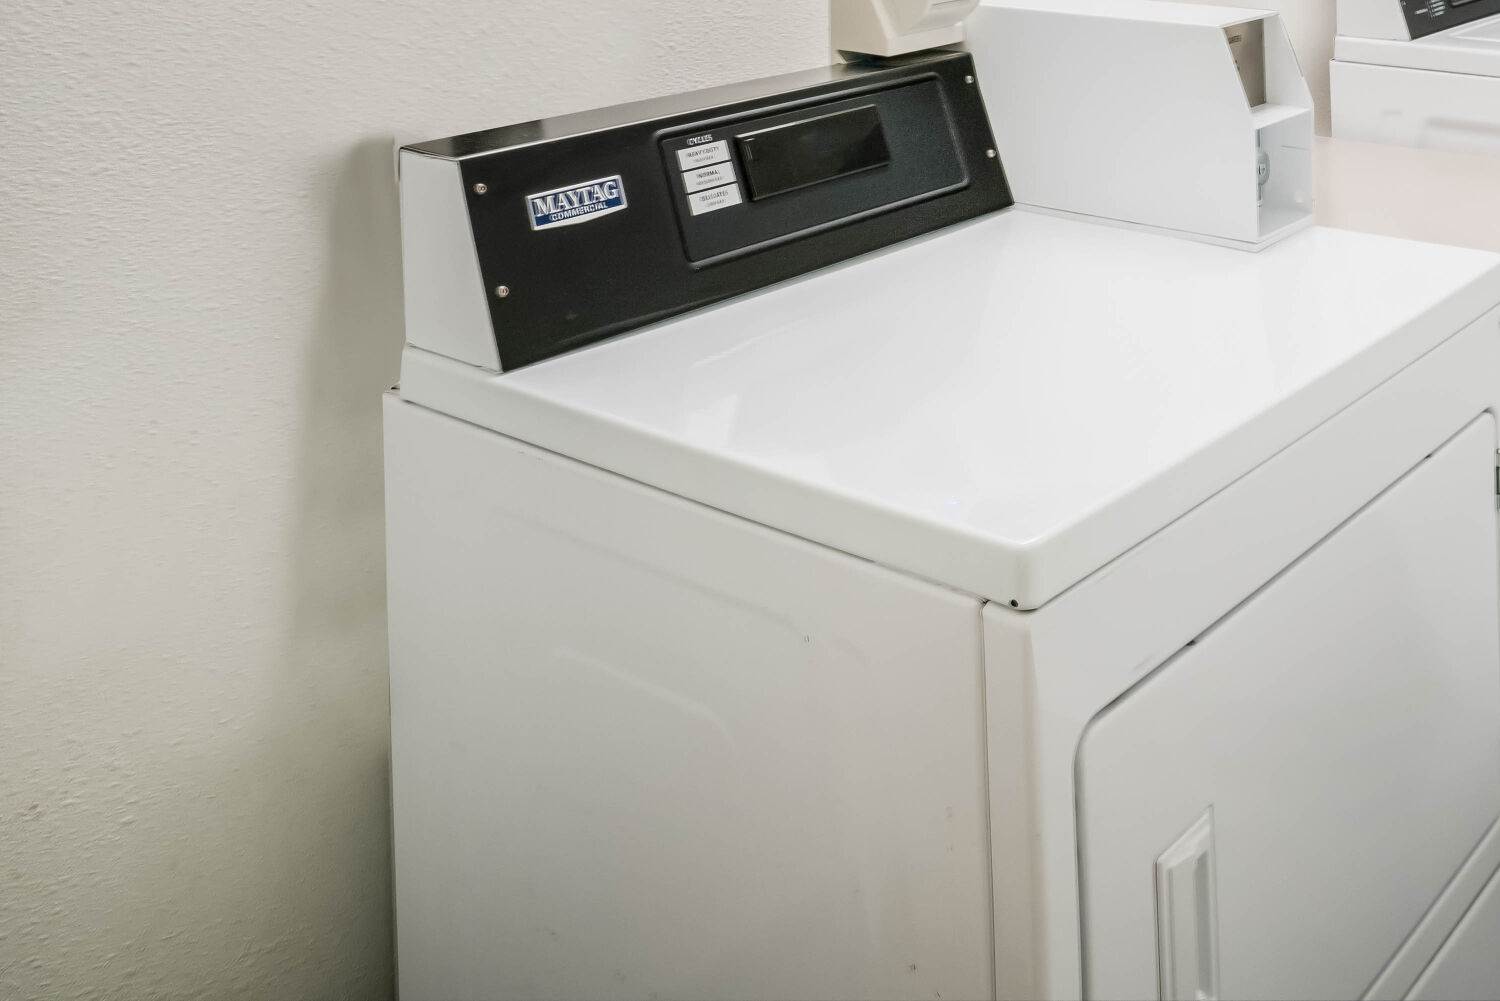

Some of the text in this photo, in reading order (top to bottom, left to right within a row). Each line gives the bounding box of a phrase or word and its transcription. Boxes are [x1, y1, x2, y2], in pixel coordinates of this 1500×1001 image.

[686, 134, 713, 146] CYCLES
[532, 181, 620, 217] MAYTAG
[549, 201, 608, 221] COMMERCIAL
